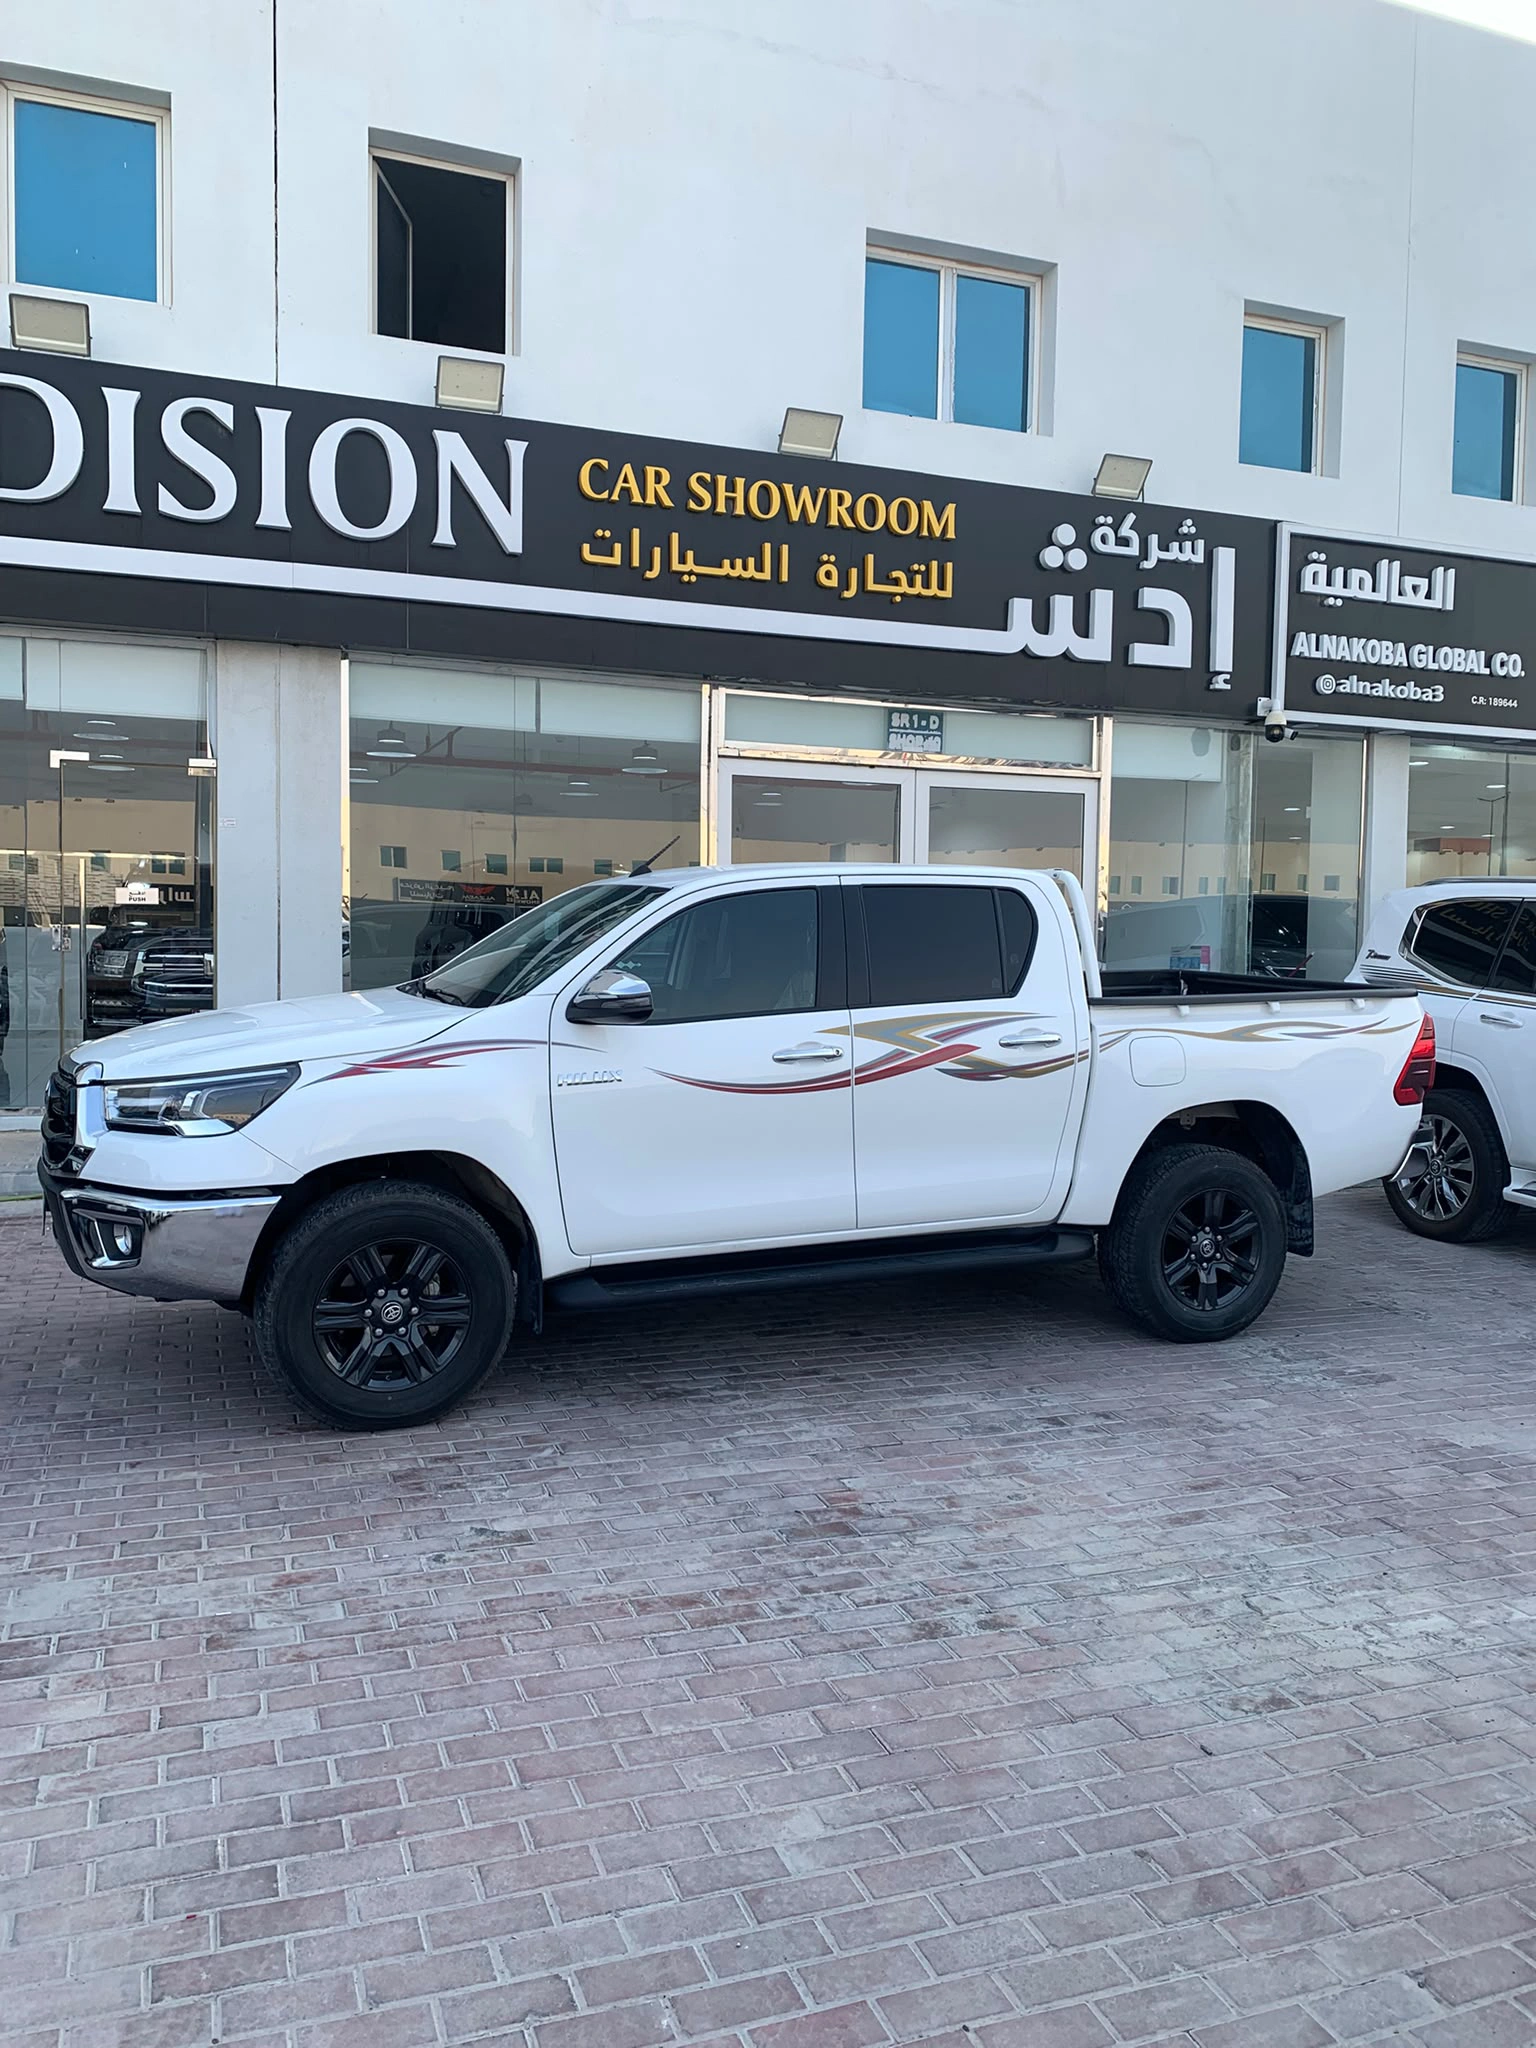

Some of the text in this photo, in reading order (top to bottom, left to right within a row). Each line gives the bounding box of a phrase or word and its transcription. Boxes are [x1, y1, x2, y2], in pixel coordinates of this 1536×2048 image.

[578, 457, 958, 541] CAR SHOWROOM
[580, 527, 954, 603] للتجارة السيارات
[1091, 512, 1205, 570] شركة
[1300, 551, 1456, 611] العالمية
[1290, 631, 1525, 679] ALNAKOBA GLOBAL CO.
[1489, 697, 1518, 708] 189644
